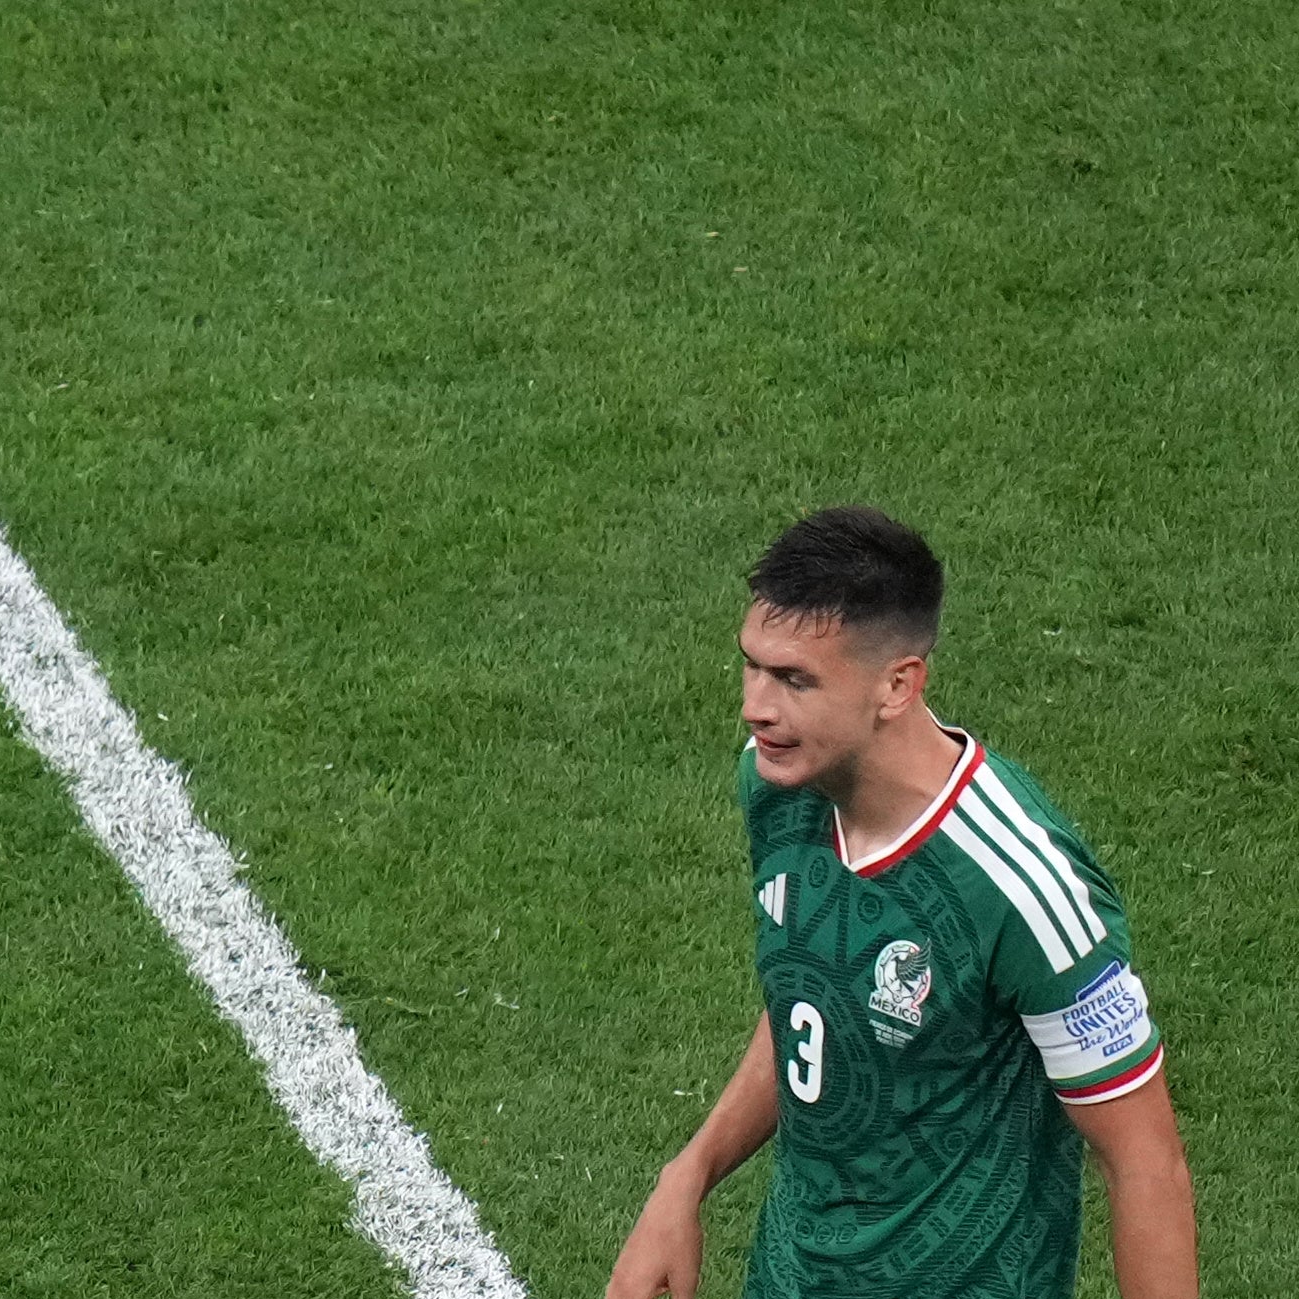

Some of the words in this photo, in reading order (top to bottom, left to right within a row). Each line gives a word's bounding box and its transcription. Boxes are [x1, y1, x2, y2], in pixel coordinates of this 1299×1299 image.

[1062, 980, 1125, 1024] FOOTBALL
[1066, 992, 1136, 1037] UNITES
[787, 1001, 824, 1103] 3
